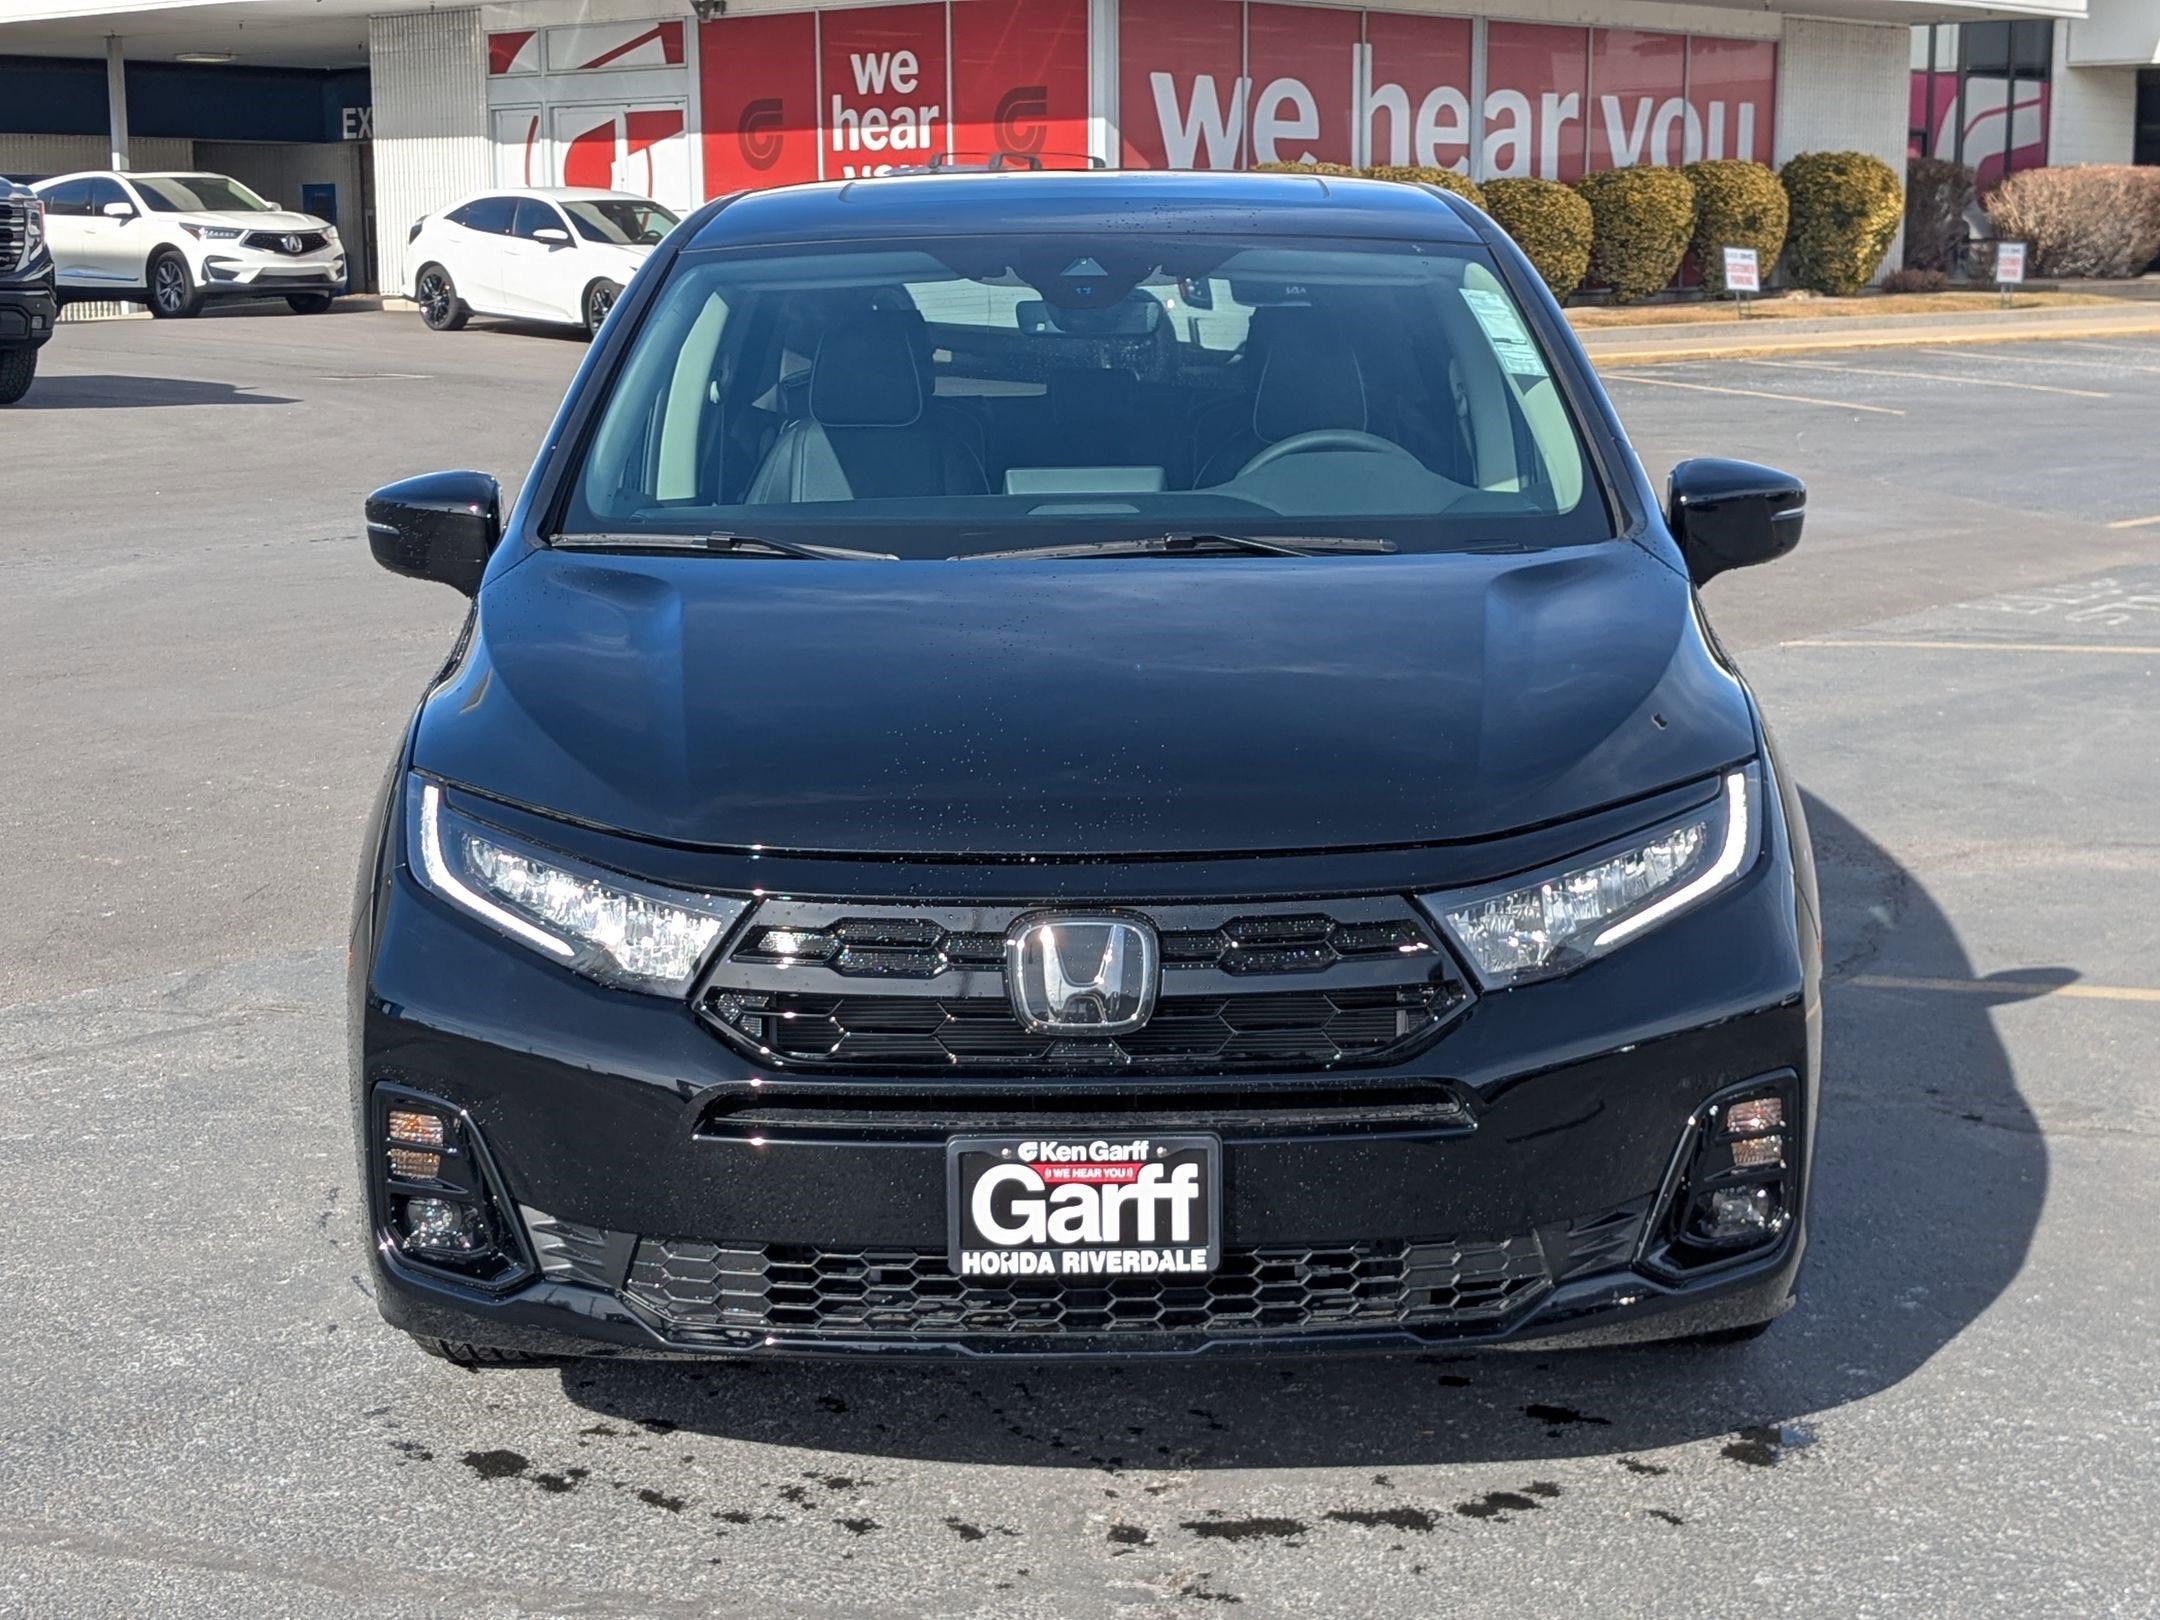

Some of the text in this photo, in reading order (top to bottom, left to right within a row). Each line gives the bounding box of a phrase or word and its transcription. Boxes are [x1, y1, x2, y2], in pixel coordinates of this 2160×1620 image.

[850, 50, 918, 95] we
[832, 94, 939, 152] hear
[1150, 43, 1754, 181] we hear you
[1040, 1140, 1149, 1162] Ken Garff
[1053, 1167, 1126, 1179] WE HEAR YOU
[971, 1163, 1199, 1246] Garff
[962, 1249, 1207, 1275] HONDA RIVERDALE
